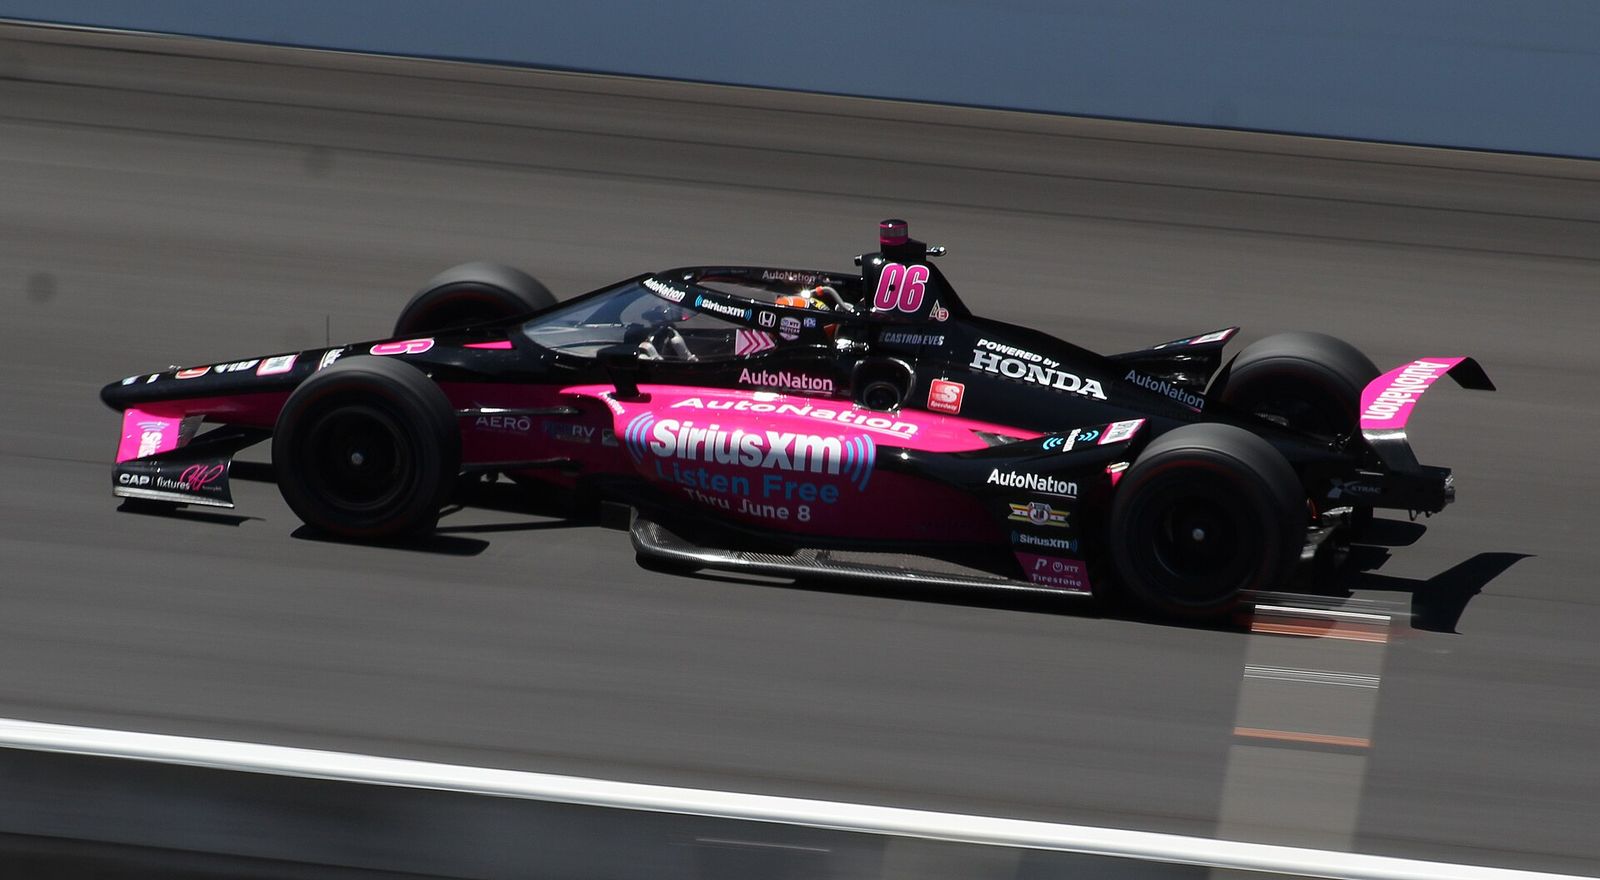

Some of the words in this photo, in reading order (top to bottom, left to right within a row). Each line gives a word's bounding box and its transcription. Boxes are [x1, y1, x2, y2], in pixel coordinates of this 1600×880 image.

[643, 277, 686, 302] AutoNation
[762, 270, 816, 285] AutoNation
[873, 262, 931, 312] 06
[976, 338, 1043, 363] POWERED
[1042, 357, 1060, 369] by
[738, 367, 833, 392] AutoNation
[969, 349, 1108, 400] HONDA
[1124, 369, 1206, 409] AutoNation
[1361, 360, 1450, 420] AutoNation
[671, 397, 919, 436] AutoNation
[118, 473, 151, 486] CAP
[156, 475, 191, 492] fixtures
[654, 460, 749, 494] Listen
[763, 474, 840, 503] Free
[987, 467, 1078, 496] AutoNation
[684, 488, 730, 510] Thru
[738, 498, 790, 520] June
[797, 505, 811, 522] 8
[1031, 573, 1082, 587] Firestone
